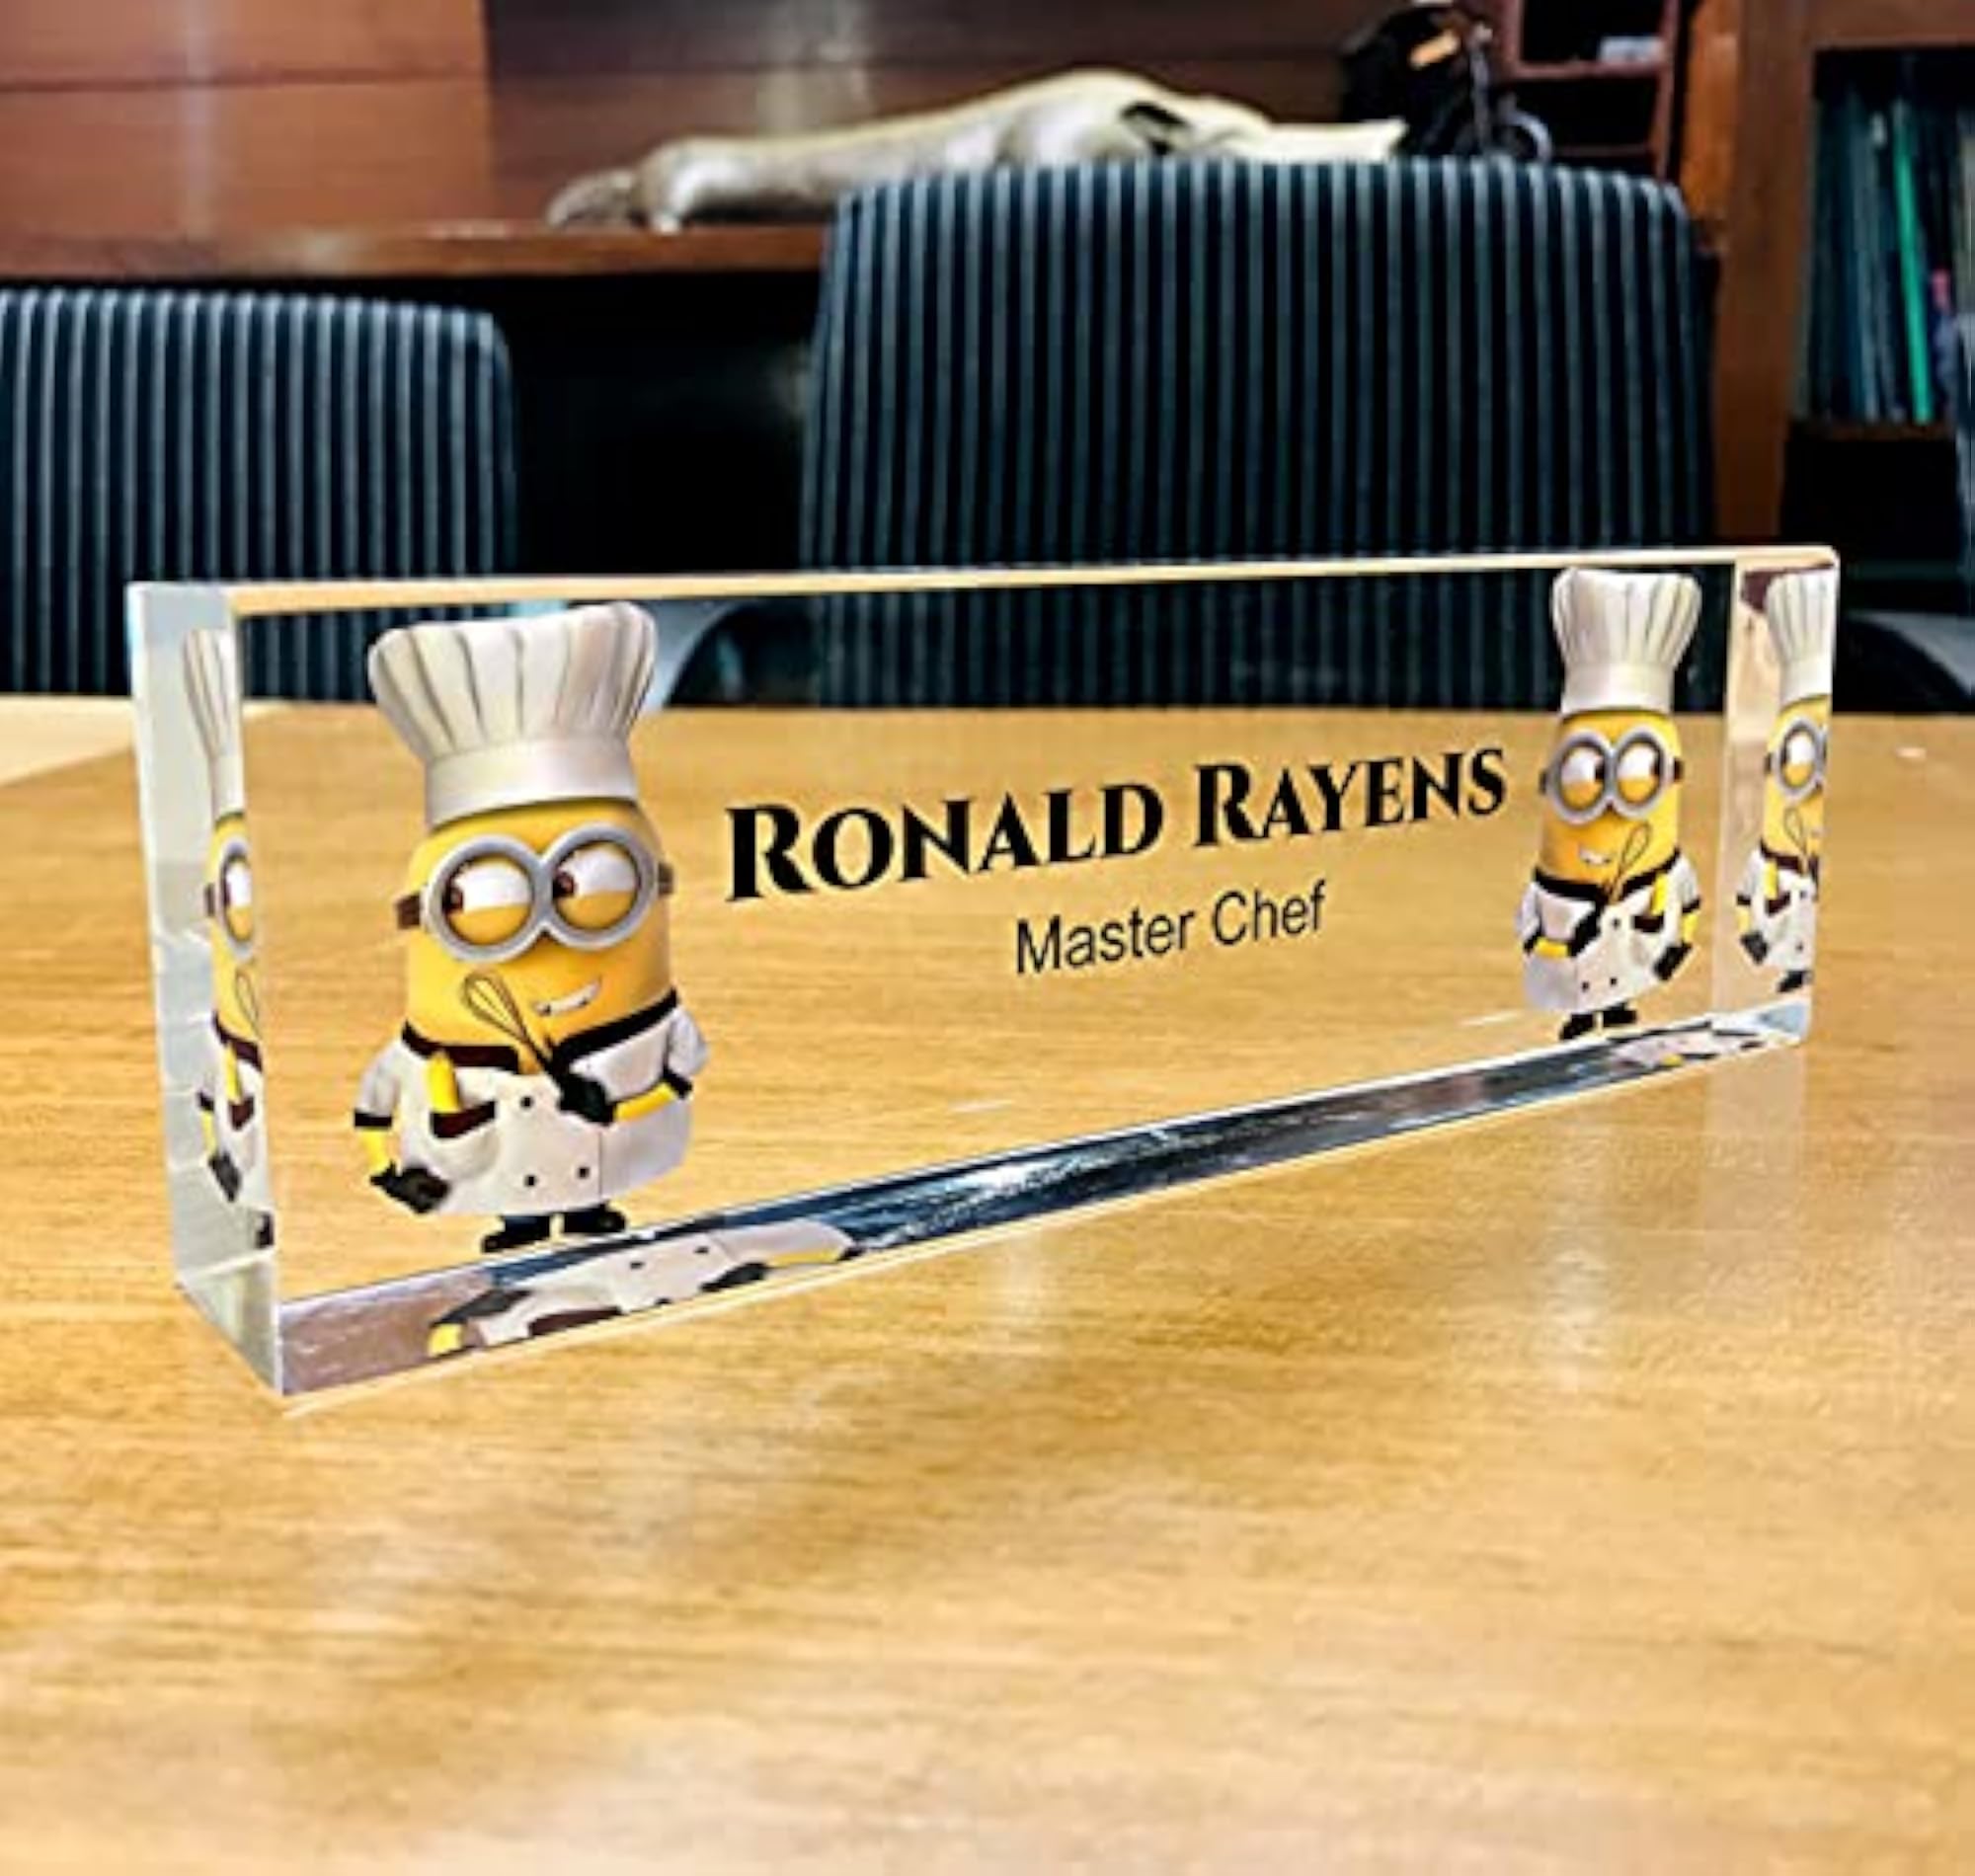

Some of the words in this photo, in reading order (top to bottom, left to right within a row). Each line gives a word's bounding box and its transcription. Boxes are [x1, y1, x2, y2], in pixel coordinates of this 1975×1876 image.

[726, 782, 1164, 901] RONALD
[1194, 747, 1507, 848] RAYENS
[1016, 908, 1195, 976] Master
[1211, 878, 1327, 947] Chef
